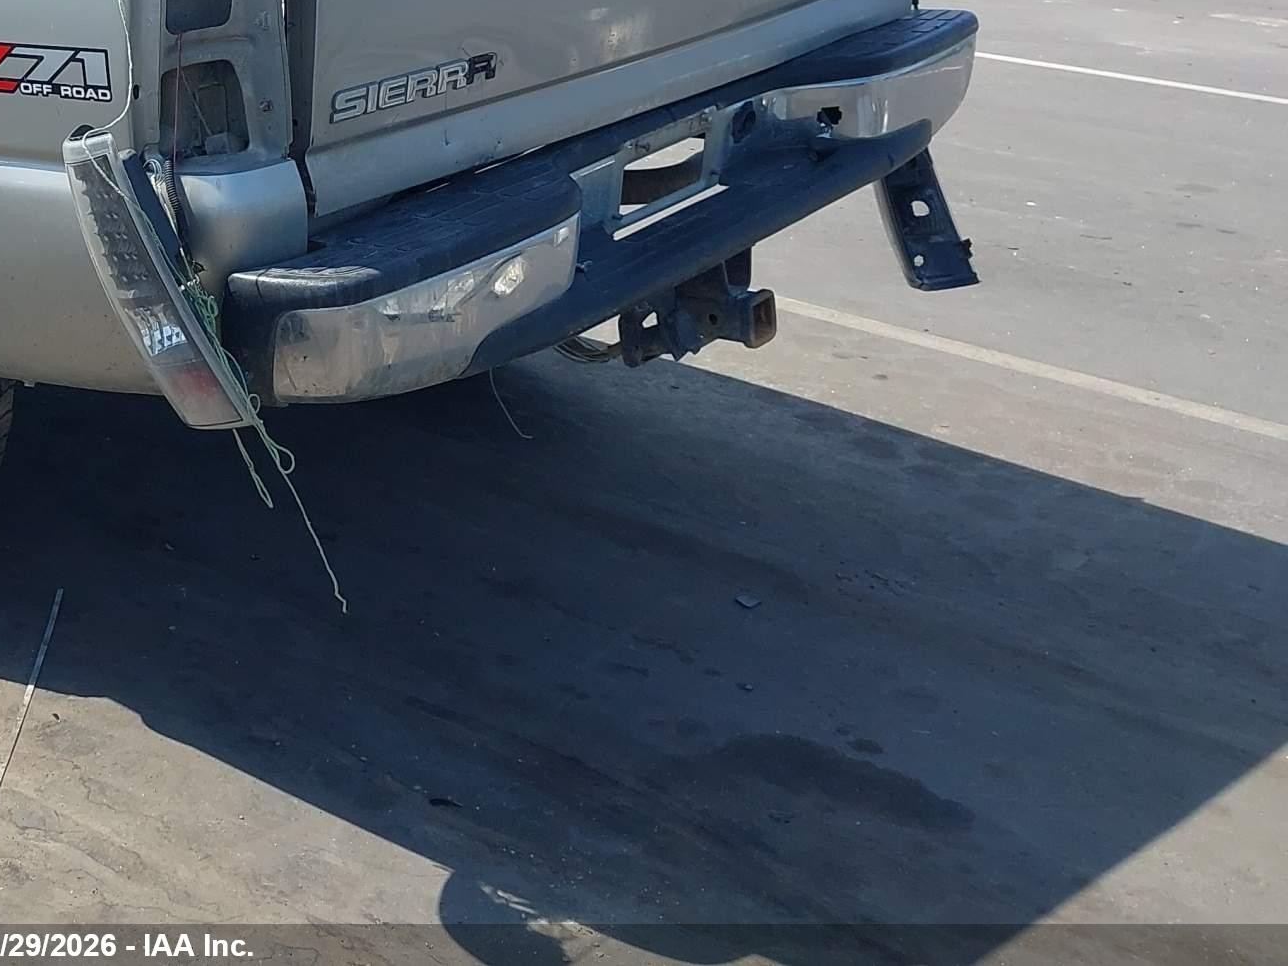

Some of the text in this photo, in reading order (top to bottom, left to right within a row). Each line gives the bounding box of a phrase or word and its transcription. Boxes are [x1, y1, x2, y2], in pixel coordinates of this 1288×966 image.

[19, 82, 112, 101] OFF ROAD
[329, 51, 498, 124] SIERRA
